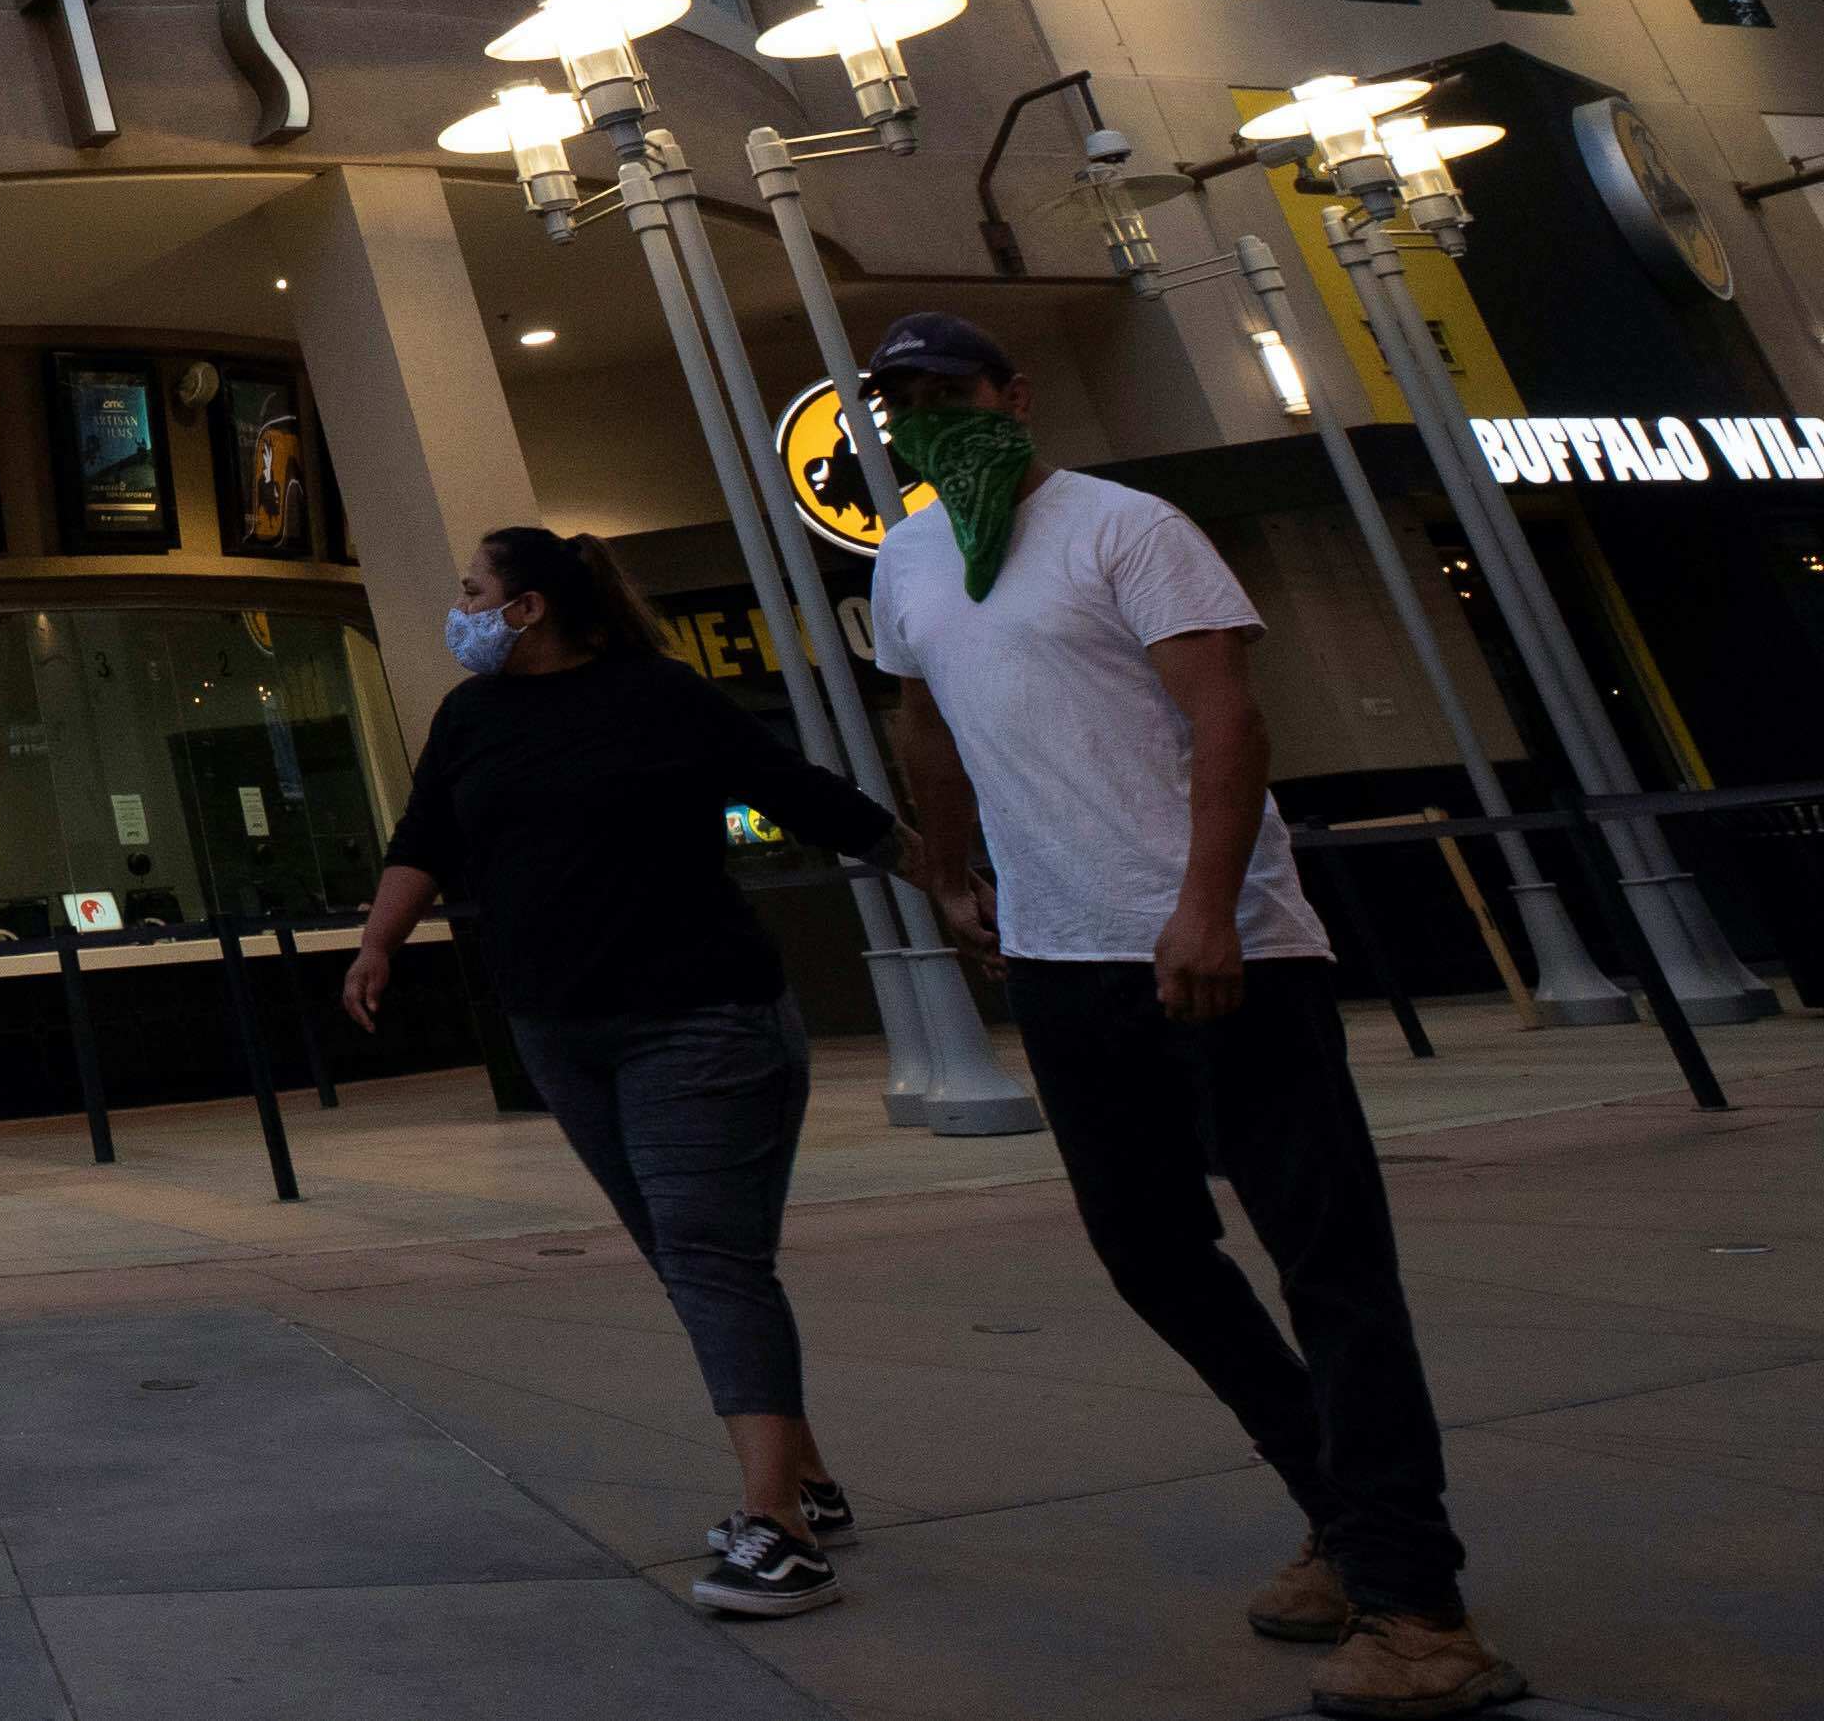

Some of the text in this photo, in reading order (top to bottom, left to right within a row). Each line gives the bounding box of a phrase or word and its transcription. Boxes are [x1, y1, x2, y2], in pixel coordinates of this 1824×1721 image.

[1469, 416, 1710, 484] BUFFALO
[94, 651, 112, 679] 3
[217, 650, 230, 676] 2
